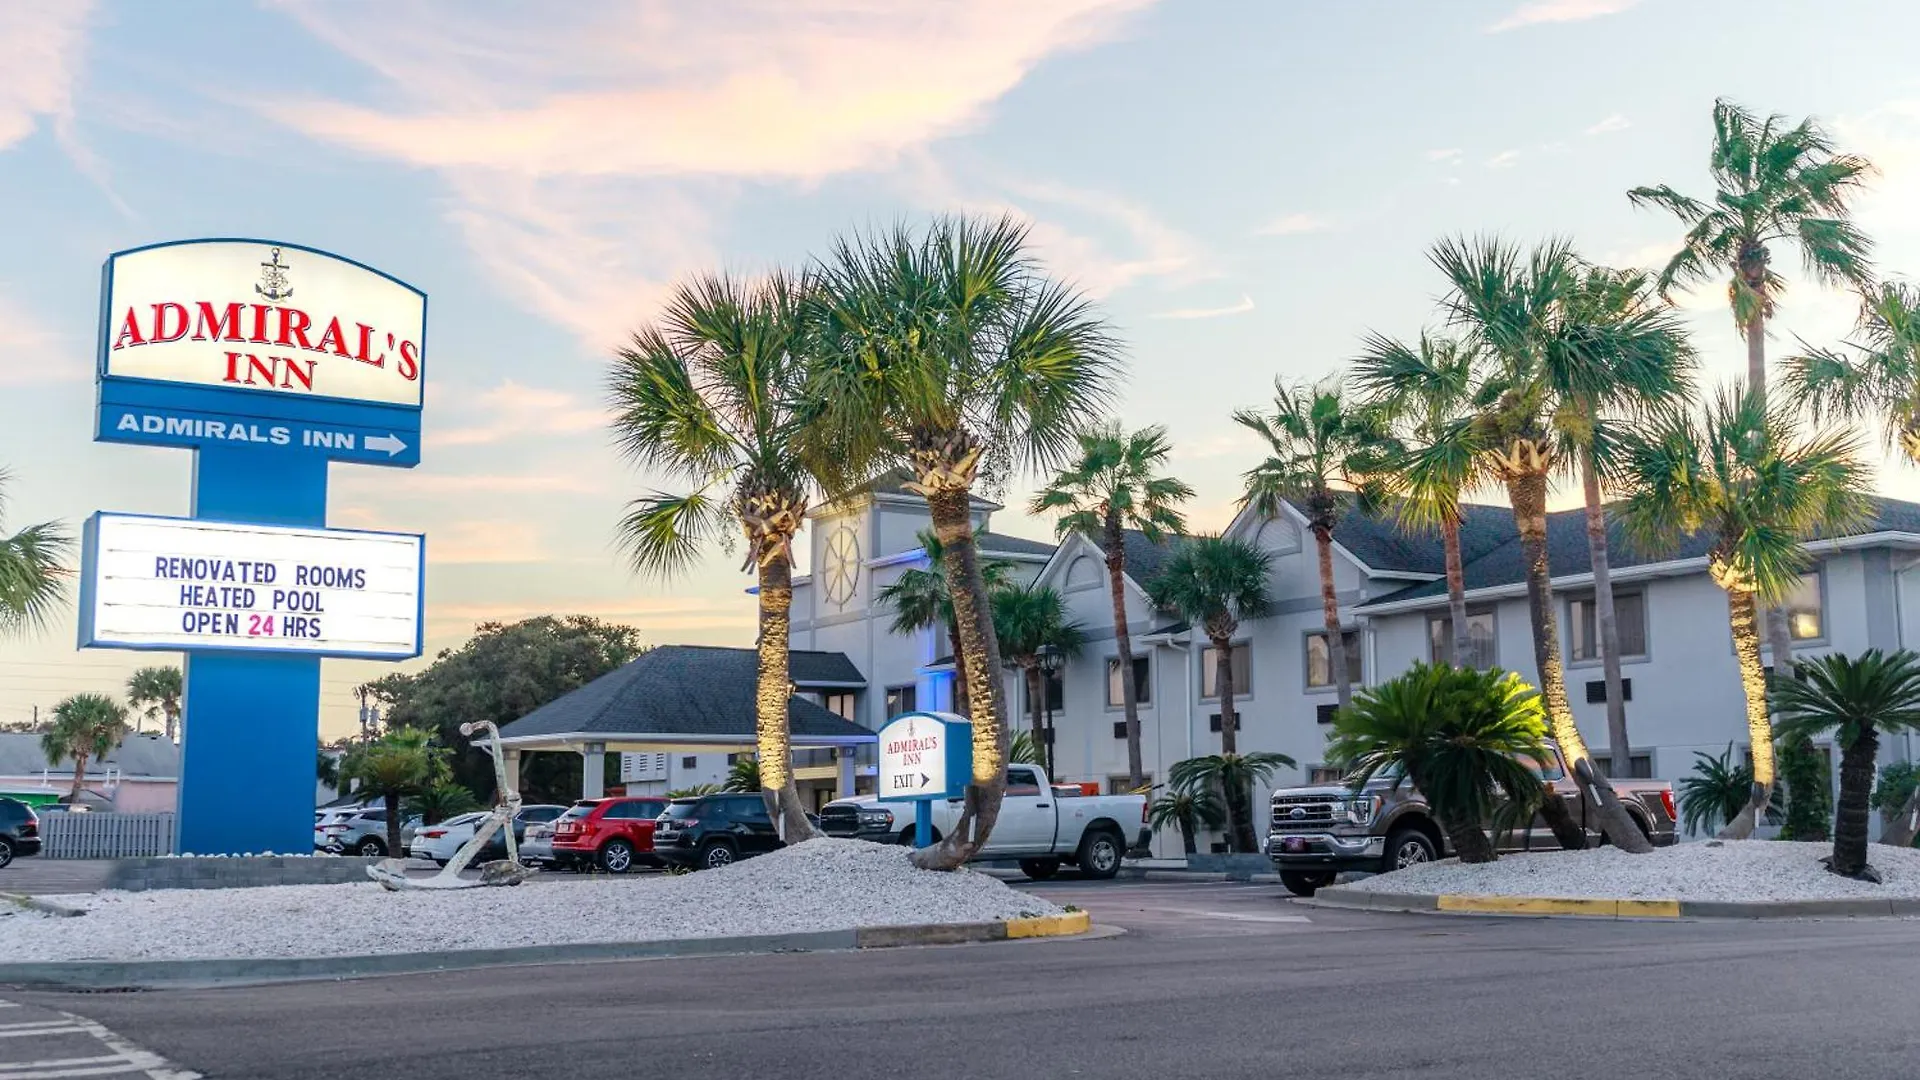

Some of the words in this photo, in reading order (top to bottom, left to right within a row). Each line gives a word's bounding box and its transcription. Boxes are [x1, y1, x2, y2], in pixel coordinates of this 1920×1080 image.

[113, 301, 418, 381] ADMIRAL'S
[223, 351, 318, 391] INN
[117, 413, 291, 445] ADMIRALS
[303, 429, 355, 449] INN
[155, 556, 277, 584] RENOVATED
[295, 565, 366, 589] ROOMS
[180, 584, 256, 609] HEATED
[273, 589, 324, 613] POOL
[182, 611, 239, 634] OPEN
[248, 614, 275, 637] 24
[283, 617, 321, 638] HRS
[887, 736, 938, 754] ADMIRAL'S
[903, 752, 921, 766] INN
[894, 774, 914, 789] EXIT
